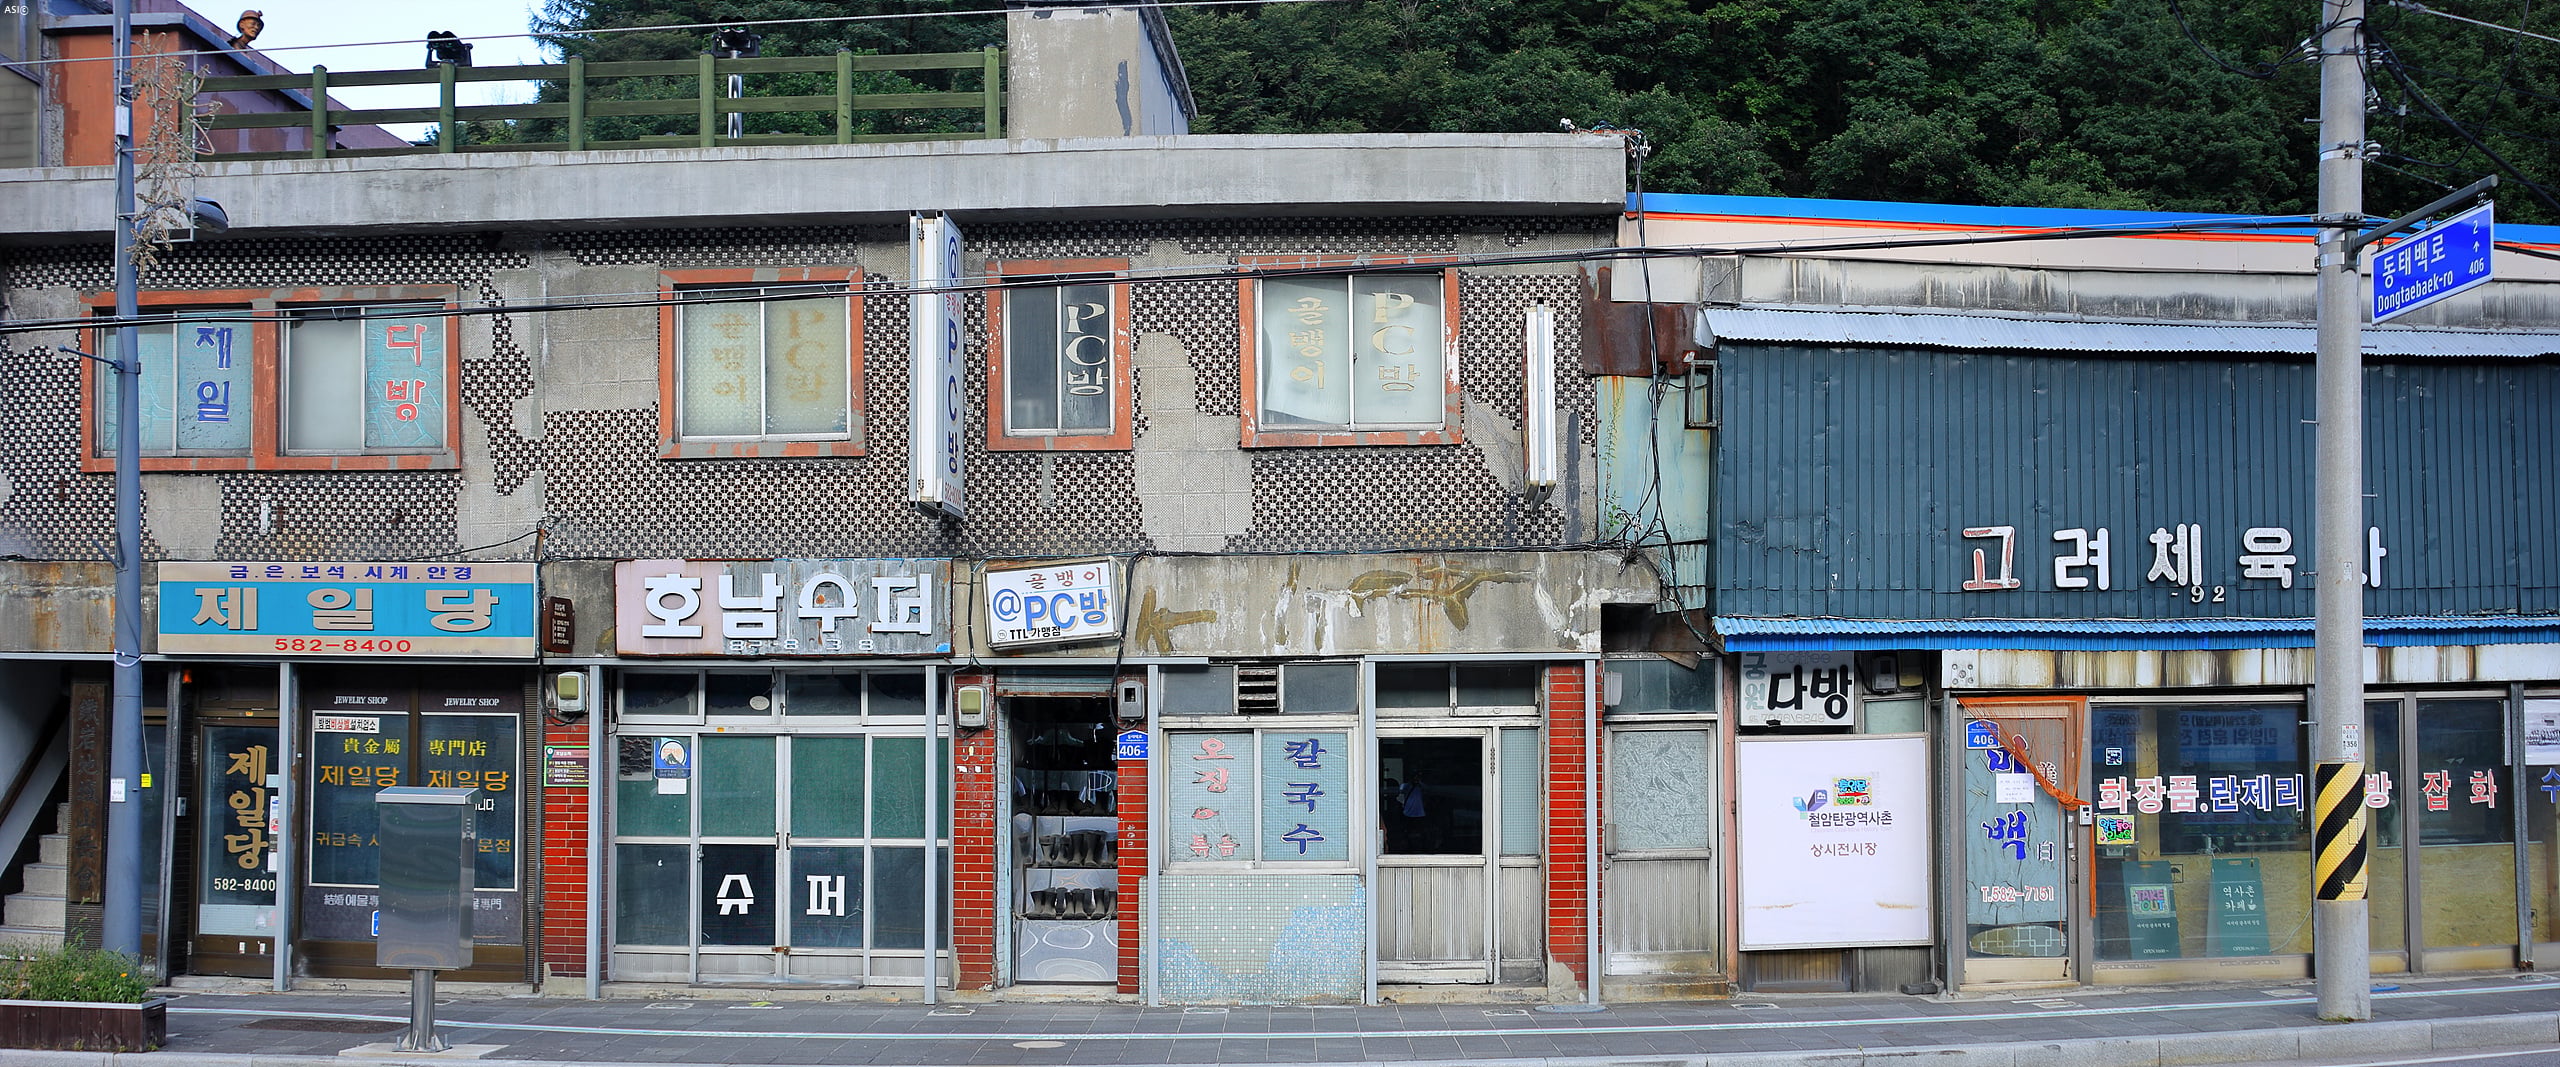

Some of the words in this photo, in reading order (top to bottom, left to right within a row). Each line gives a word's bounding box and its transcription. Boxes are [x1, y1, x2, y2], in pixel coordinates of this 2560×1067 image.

[2473, 220, 2479, 235] 2
[2382, 233, 2446, 289] 동태백로
[2468, 257, 2485, 275] 406
[2377, 270, 2454, 313] Dongtaebaek-ro
[1287, 296, 1329, 390] 골뱅이
[195, 326, 233, 423] 제일
[386, 323, 428, 422] 다방
[1025, 566, 1101, 590] 골뱅이
[192, 586, 500, 633] 제일당
[642, 572, 933, 639] 호남수퍼
[1009, 628, 1029, 640] TTL
[1031, 626, 1061, 638] 가맹점
[274, 638, 412, 652] 582-8400
[1742, 652, 1768, 711] 궁원
[334, 695, 366, 705] JEWELRY
[367, 696, 388, 705] SHOP
[1767, 663, 1854, 720] 다방
[444, 697, 477, 706] JEWELRY
[478, 698, 500, 707] SHOP
[343, 737, 400, 755] 貴金屬
[1973, 734, 1994, 746] 406
[1119, 745, 1149, 757] 406-
[319, 765, 400, 787] 제일당
[427, 769, 510, 792] 제일당
[1281, 737, 1328, 856] 칼국수
[224, 744, 270, 870] 제일당
[1808, 810, 1893, 828] 철암탄광역사촌
[315, 831, 362, 847] 귀금속
[1810, 842, 1878, 858] 상시전시장
[213, 878, 276, 892] 582-8400
[1981, 886, 2055, 902] T.582-7151
[2134, 889, 2165, 901] TAKE
[2140, 899, 2165, 912] OUT
